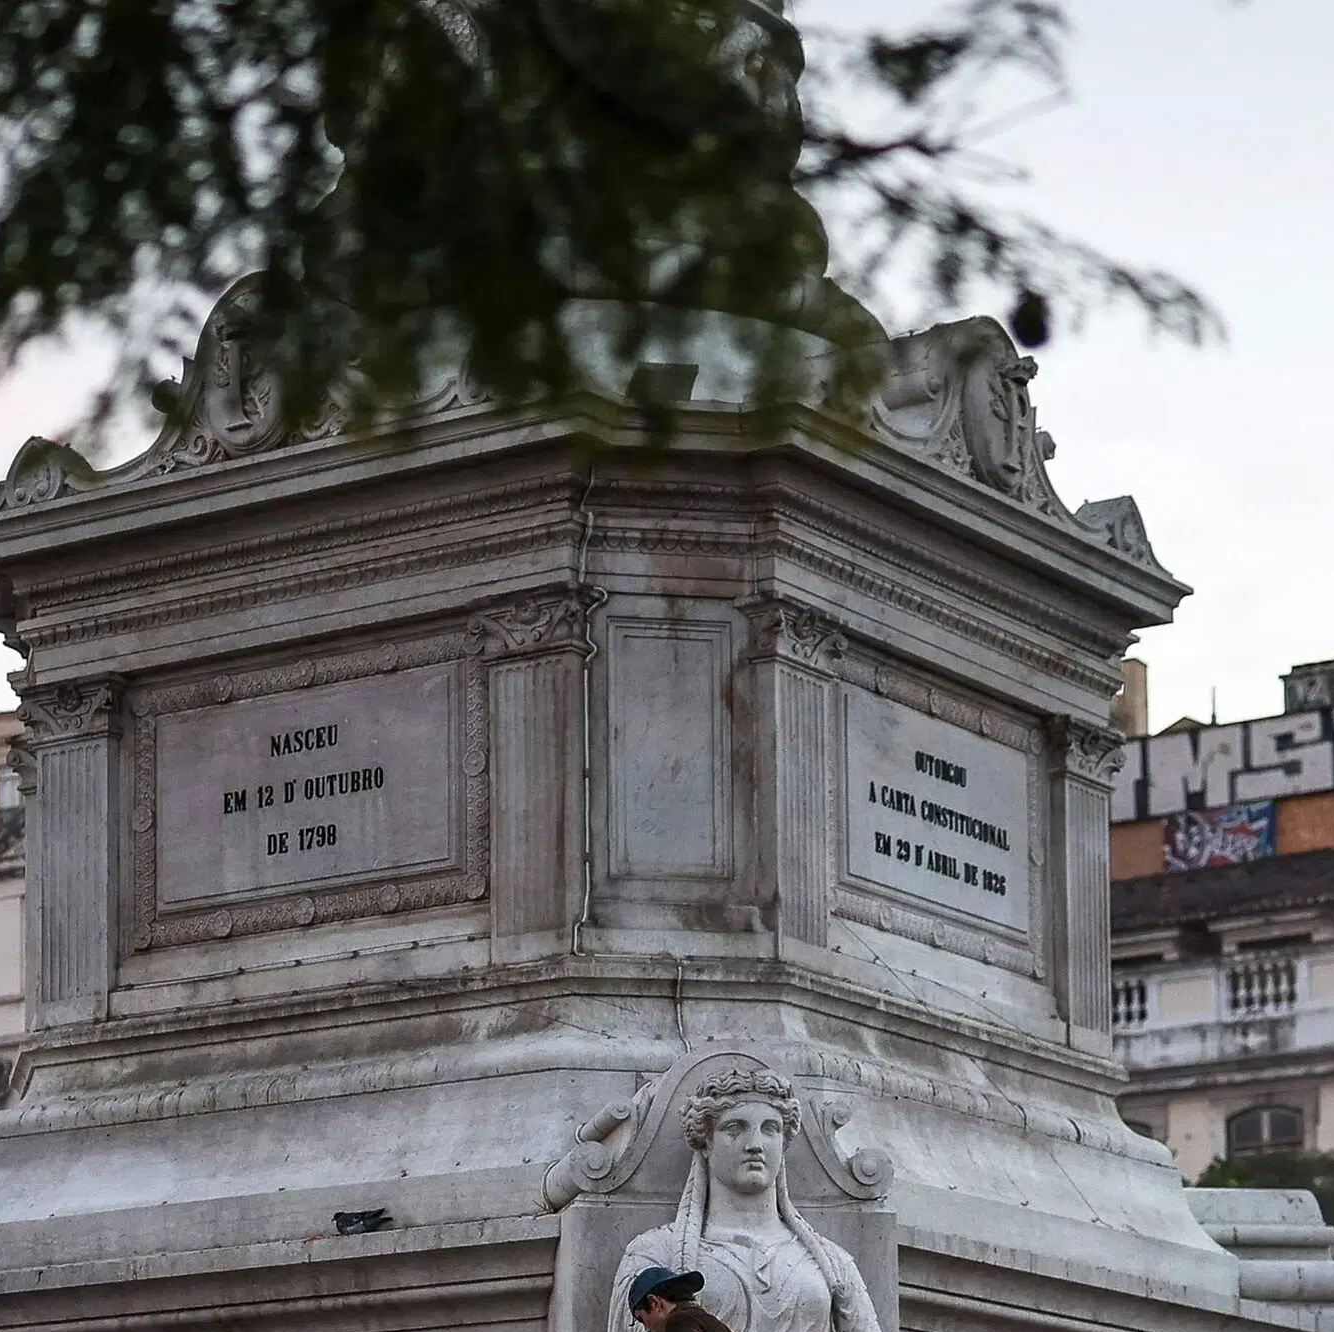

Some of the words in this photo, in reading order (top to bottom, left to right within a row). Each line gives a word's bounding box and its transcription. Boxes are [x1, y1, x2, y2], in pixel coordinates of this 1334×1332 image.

[270, 724, 338, 757] NASCEU
[224, 791, 247, 814] EM
[257, 785, 274, 808] 12
[304, 766, 383, 800] OUTUBRO
[915, 750, 967, 788] OUTORGOU
[868, 781, 876, 803] A
[881, 785, 916, 817] CARTA
[921, 800, 1010, 851] CONSTITUCIONAL
[267, 832, 288, 855] DE
[298, 824, 336, 851] 1798
[875, 831, 891, 857] EM
[896, 839, 910, 862] 29
[964, 862, 978, 886] DE
[982, 869, 1006, 896] 1826
